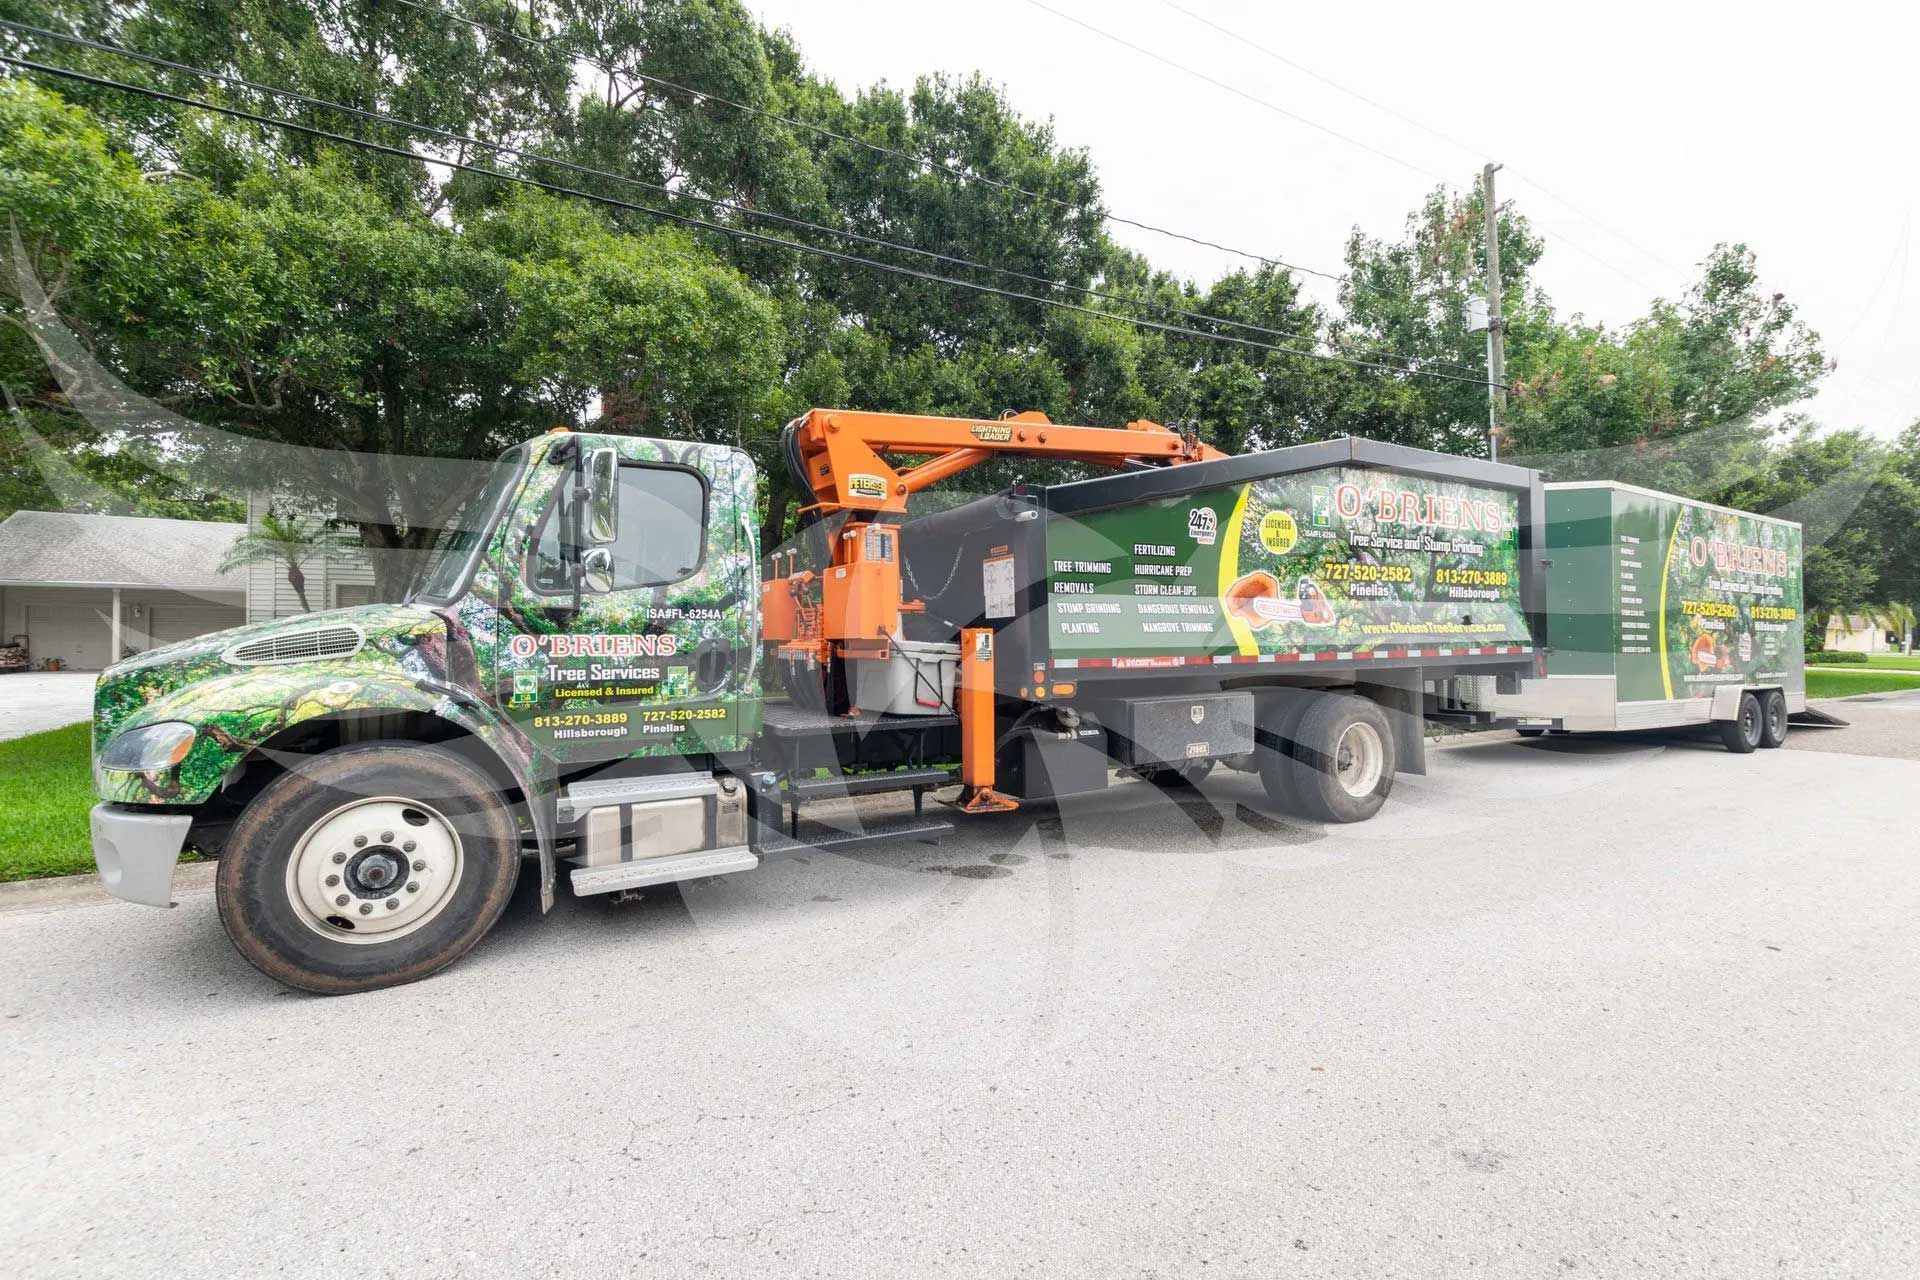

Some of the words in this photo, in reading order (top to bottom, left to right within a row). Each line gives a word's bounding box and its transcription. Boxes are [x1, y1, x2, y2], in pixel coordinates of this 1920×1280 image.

[971, 425, 1012, 434] LIGHTNING
[979, 432, 1010, 441] LOADER
[1336, 485, 1502, 532] O'BRIENS
[1265, 519, 1291, 530] LICENSED
[1266, 537, 1290, 547] INSURED
[1350, 530, 1369, 546] Tree
[1371, 531, 1403, 549] Service
[1404, 536, 1420, 550] and
[1424, 537, 1450, 554] Stump
[1452, 540, 1483, 557] Grinding
[1134, 544, 1175, 556] FERTILIZING
[1053, 560, 1072, 572] TREE
[1074, 562, 1111, 574] TRIMMING
[1134, 564, 1174, 576] HURRICANE
[1175, 566, 1192, 576] PREP
[1324, 563, 1411, 582] 727-520-2582
[1436, 569, 1507, 586] 813-270-3889
[1054, 582, 1094, 594] REMOVALS
[1134, 585, 1159, 595] STORM
[1160, 585, 1197, 596] CLEAN-UPS
[1350, 584, 1389, 597] Pinellas
[1449, 586, 1500, 601] Hillsborough
[646, 609, 721, 620] ISA#FL-6254A
[1057, 603, 1084, 614] STUMP
[1085, 603, 1121, 614] GRINDING
[1137, 603, 1179, 615] DANGEROUS
[1180, 604, 1215, 615] REMOVALS
[1061, 622, 1100, 634] PLANTING
[1142, 622, 1180, 632] MANGROVE
[1180, 622, 1214, 633] TRIMMING
[511, 634, 678, 657] O'BRIENS
[547, 664, 586, 681] Tree
[590, 663, 660, 681] Services
[555, 687, 602, 698] Licensed
[604, 686, 615, 696] &
[616, 685, 654, 696] Insured
[534, 712, 628, 728] 813-270-3889
[643, 709, 727, 722] 727-520-2582
[554, 725, 628, 739] Hillsborough
[643, 724, 686, 734] Pinellas
